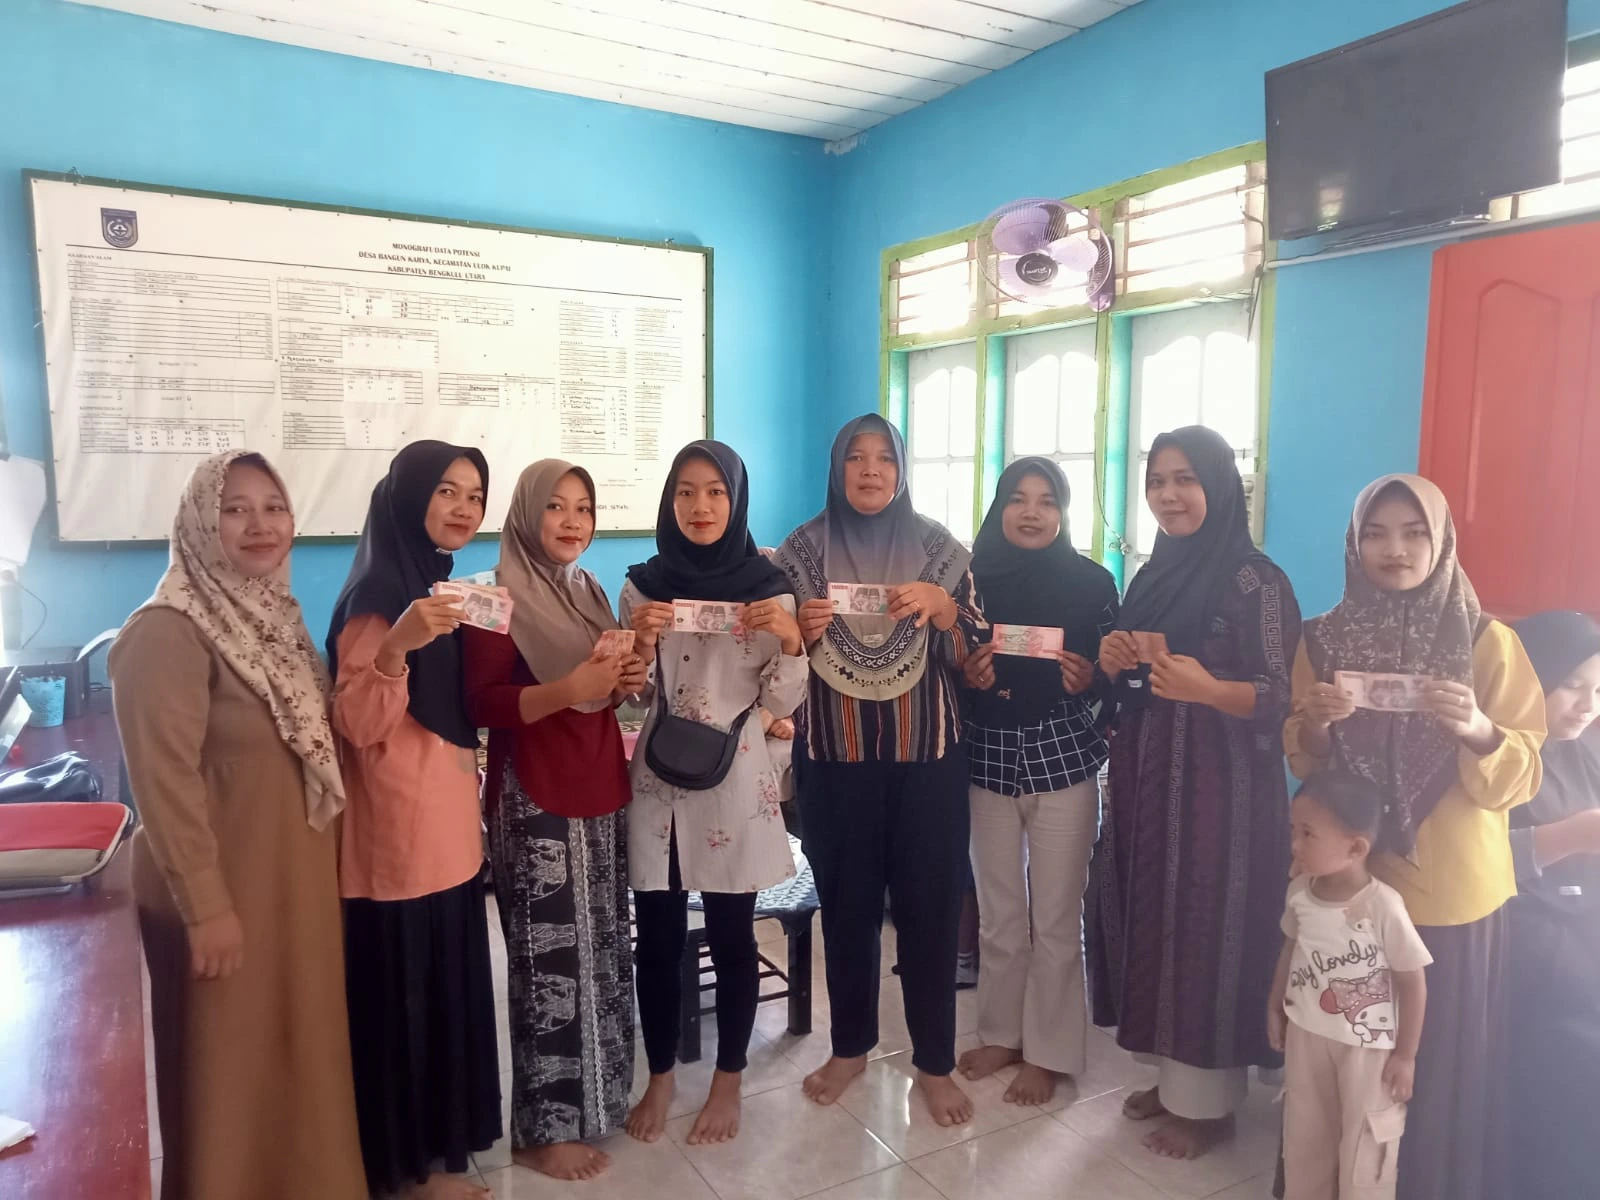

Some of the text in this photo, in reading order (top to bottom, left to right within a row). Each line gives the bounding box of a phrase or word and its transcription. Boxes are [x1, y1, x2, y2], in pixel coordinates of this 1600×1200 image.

[392, 243, 432, 252] MONOGRAFI
[453, 249, 480, 257] POTENSI
[359, 251, 377, 259] DESA
[378, 253, 406, 262] BANGUN
[433, 259, 472, 268] KECAMATAN
[388, 266, 486, 280] KABUPATEN BENGKULU UTARA
[1312, 939, 1378, 975] lovely
